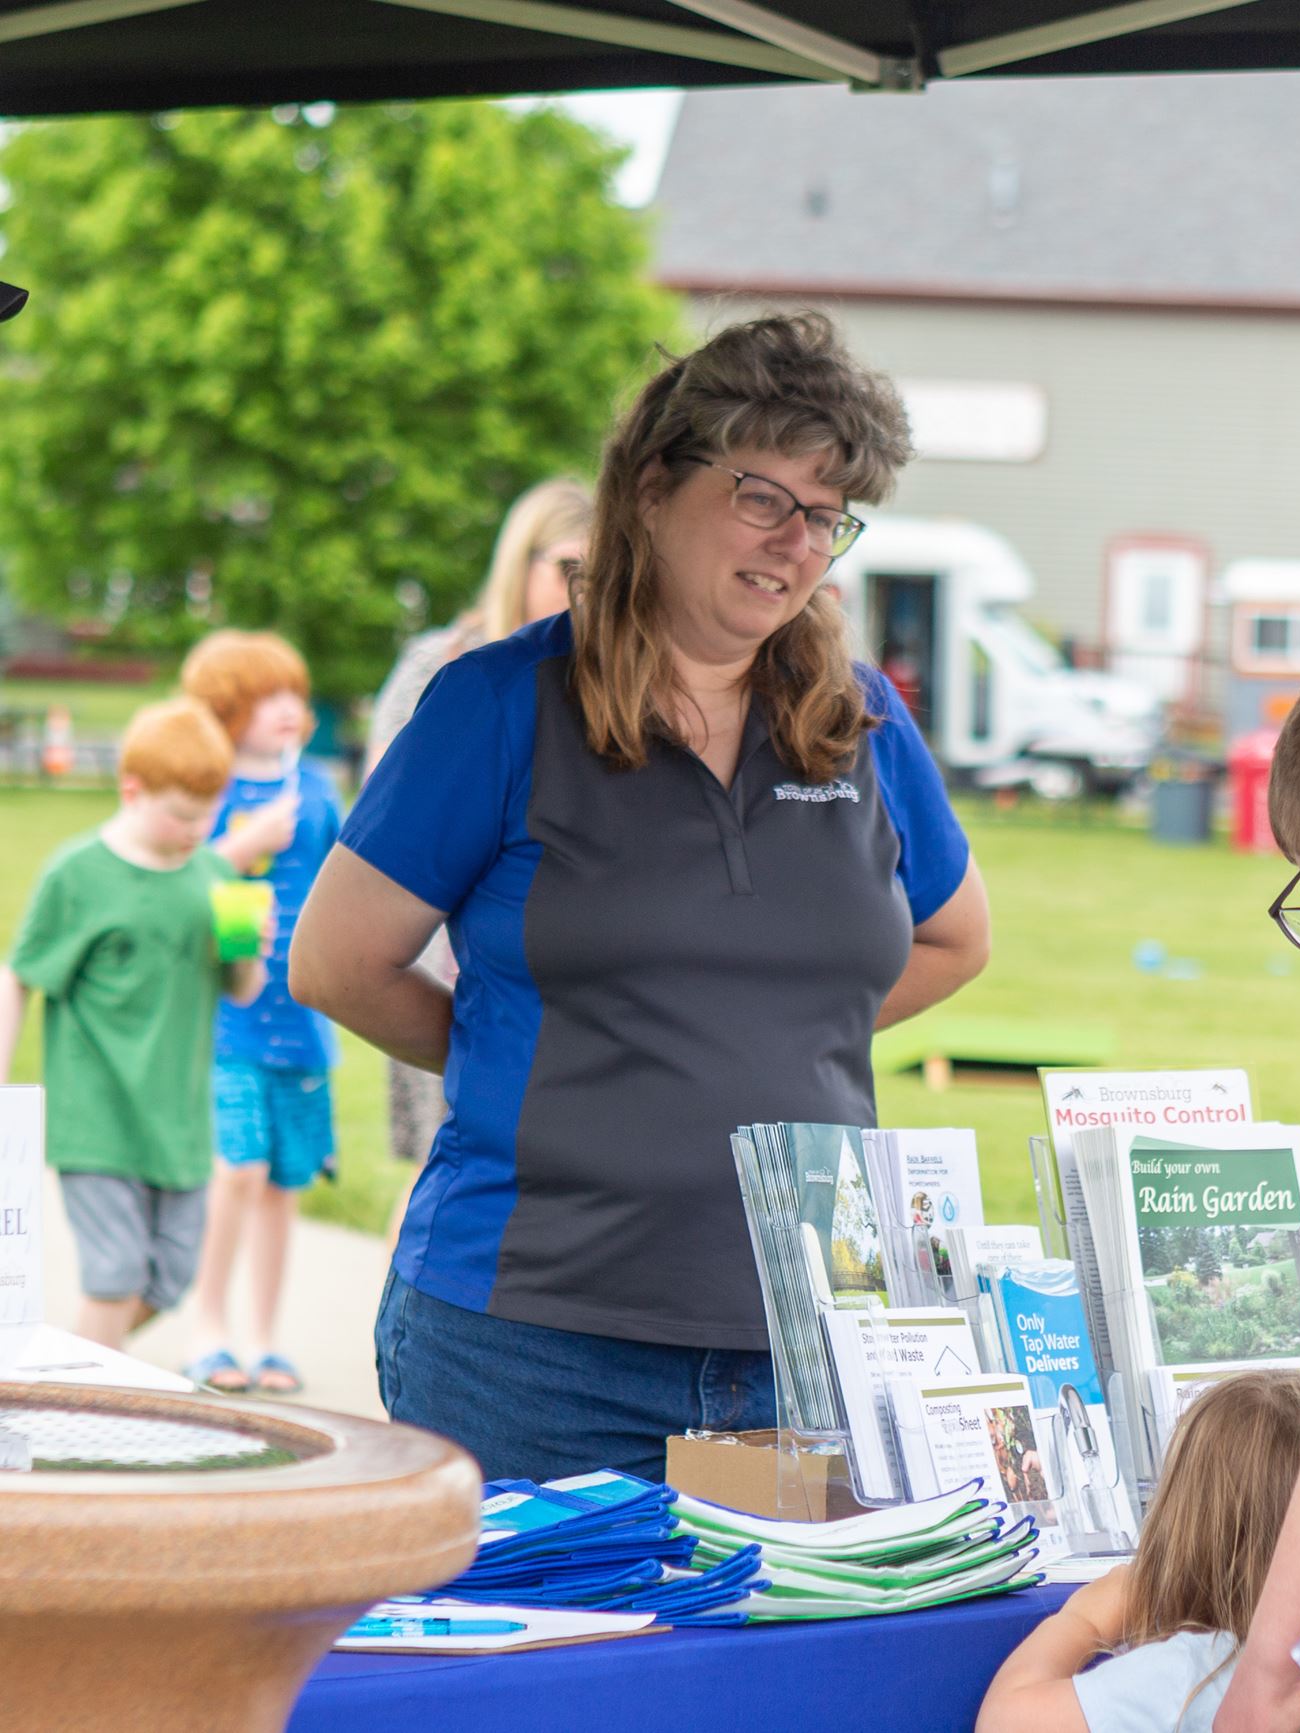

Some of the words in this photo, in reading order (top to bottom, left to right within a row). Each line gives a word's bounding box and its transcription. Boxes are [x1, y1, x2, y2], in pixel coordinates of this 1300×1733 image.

[774, 786, 860, 803] Brownsburg
[1099, 1086, 1192, 1102] Brownsburg
[1055, 1107, 1156, 1126] Mosquito
[1163, 1104, 1246, 1124] Control
[1131, 1158, 1164, 1174] Build
[1164, 1163, 1192, 1179] your
[1194, 1162, 1220, 1174] own
[1139, 1185, 1198, 1213] Rain
[1202, 1181, 1296, 1218] Garden
[0, 1208, 27, 1235] EL
[1017, 1313, 1045, 1334] Only
[1020, 1335, 1043, 1355] Tap
[1043, 1333, 1080, 1350] Water
[899, 1348, 925, 1362] Waste
[1025, 1355, 1079, 1373] Delivers
[959, 1416, 982, 1431] Sheet
